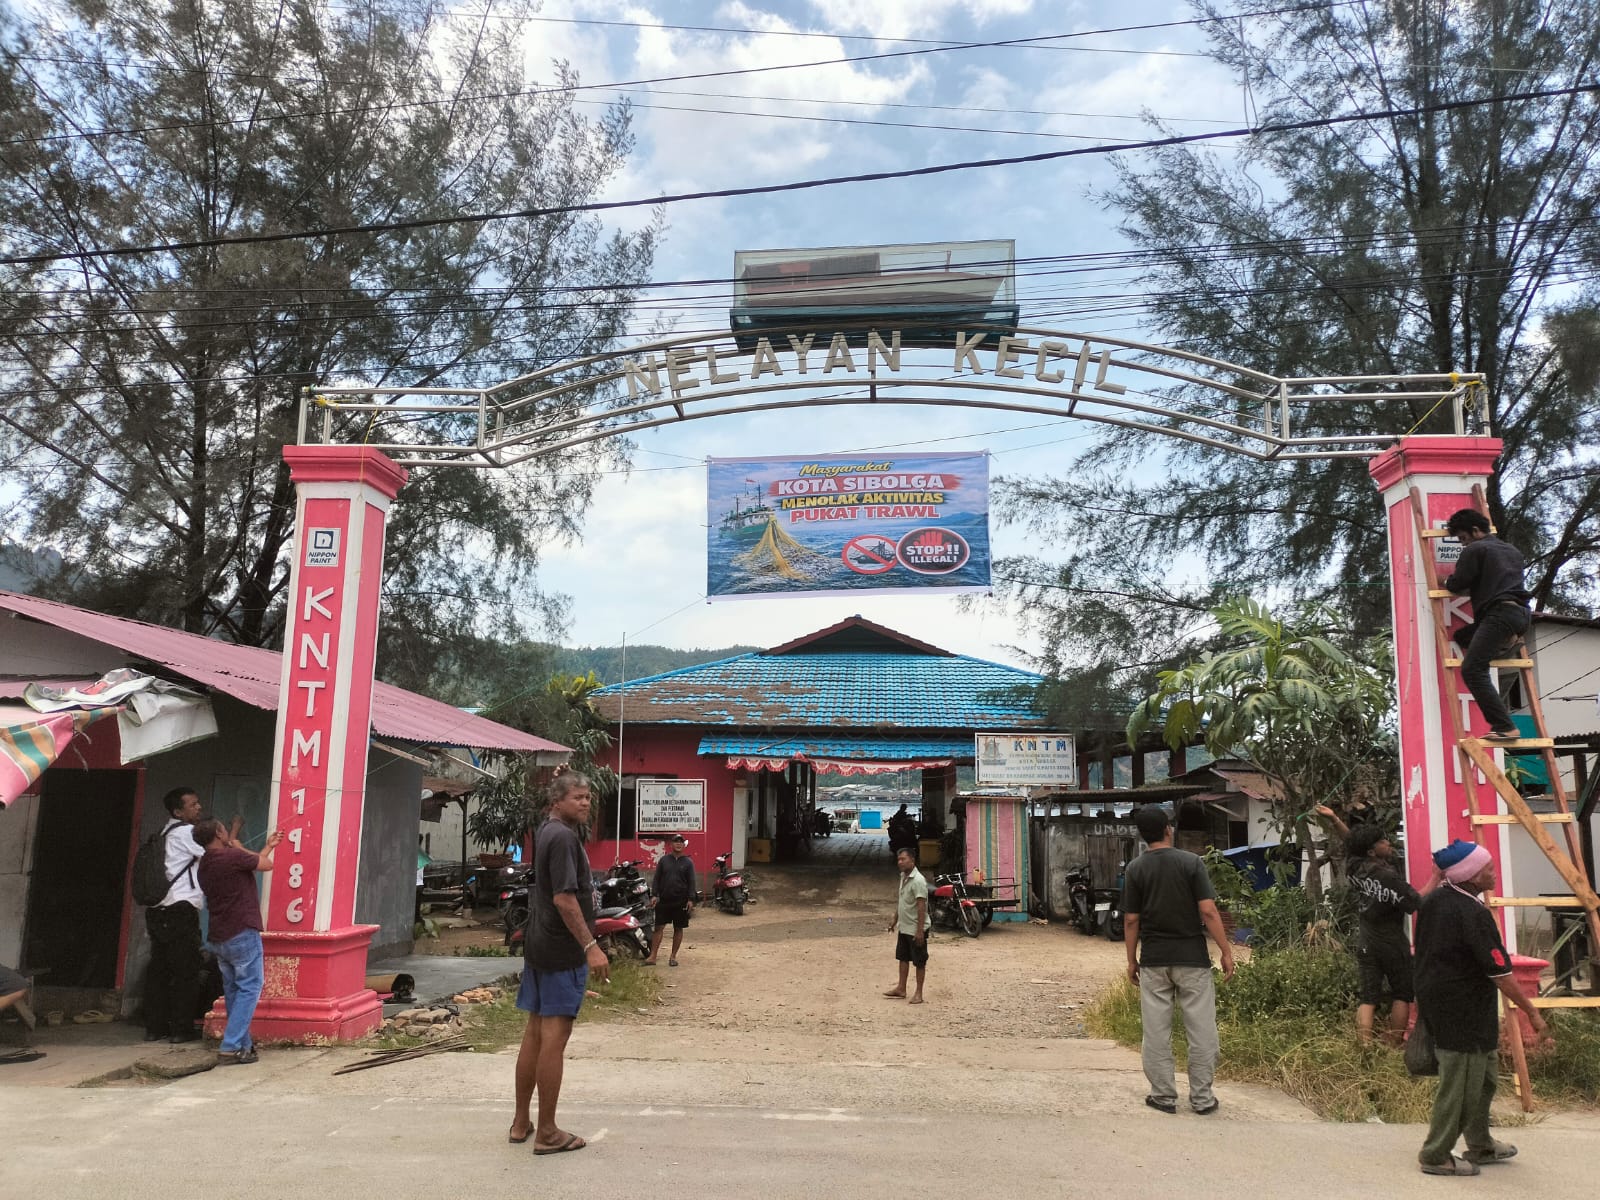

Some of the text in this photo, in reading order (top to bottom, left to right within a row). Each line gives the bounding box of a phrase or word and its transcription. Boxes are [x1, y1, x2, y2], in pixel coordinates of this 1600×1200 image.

[623, 330, 1127, 400] NELAYAN KECIL
[799, 461, 894, 477] Masyarakat
[778, 474, 945, 495] KOTA SIBOLGA
[781, 492, 945, 509] MENOLAK AKTIVITAS
[790, 505, 941, 524] PUKAT TRAWL
[906, 545, 945, 555] STOP
[910, 555, 958, 563] ILLEGAL!
[1013, 740, 1067, 751] KNTM
[285, 586, 334, 923] KNTM 1986
